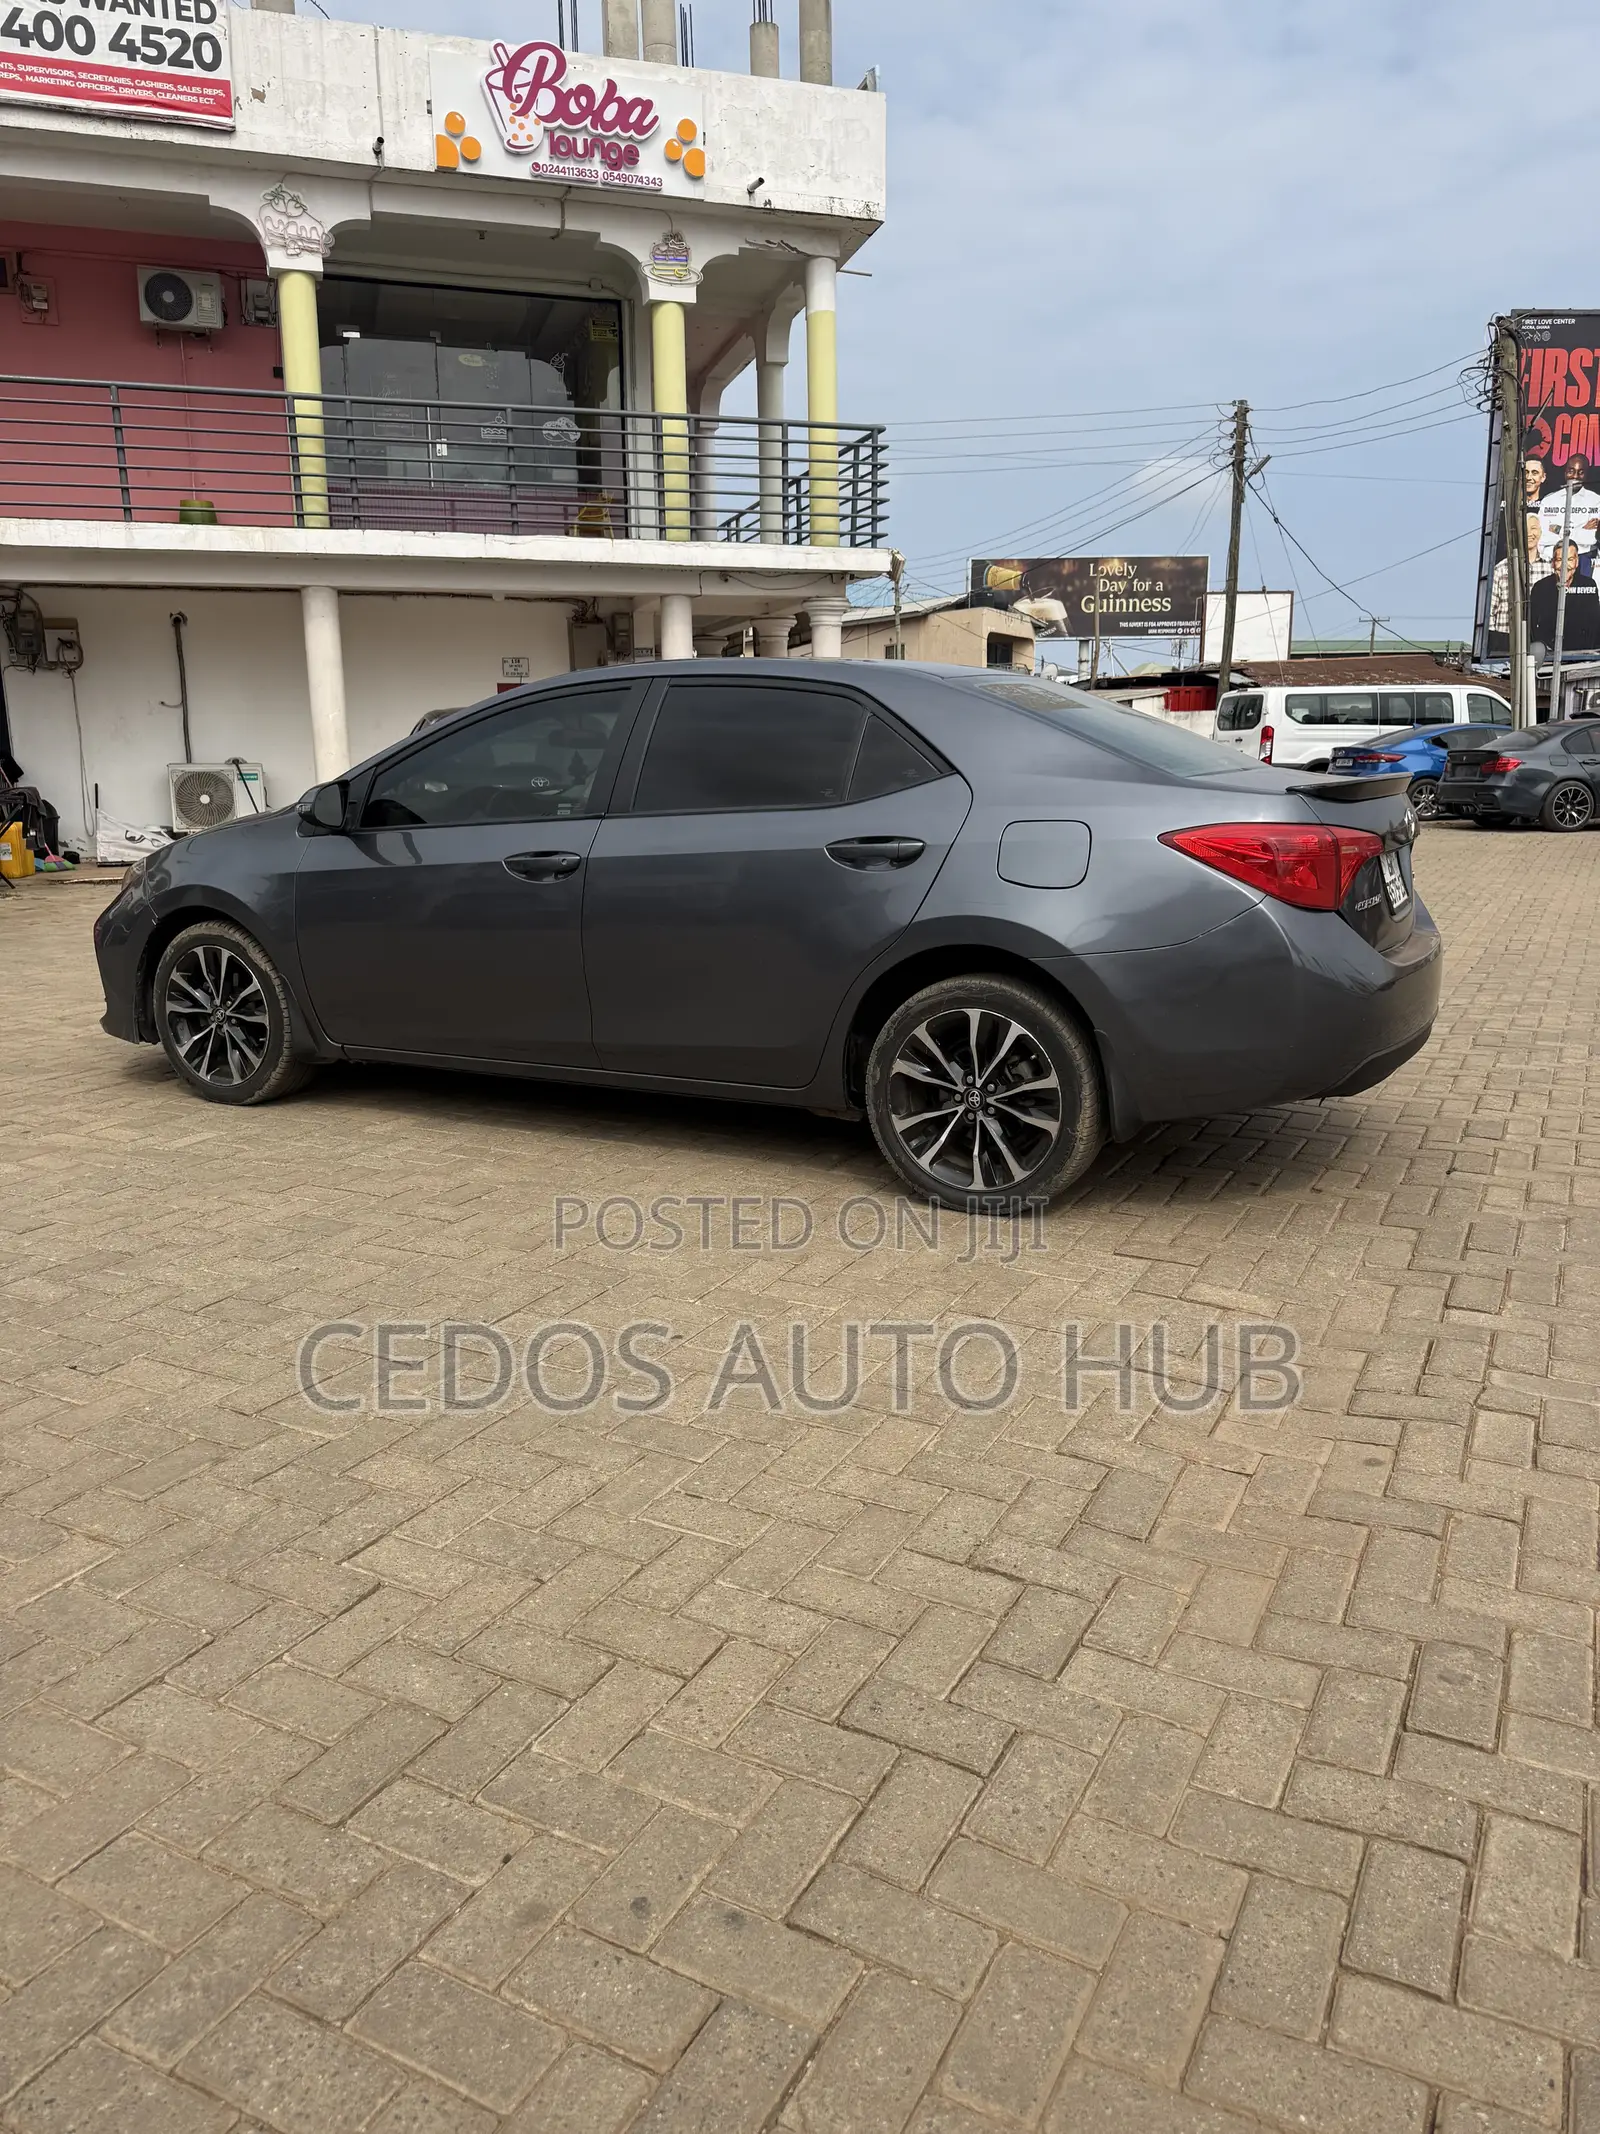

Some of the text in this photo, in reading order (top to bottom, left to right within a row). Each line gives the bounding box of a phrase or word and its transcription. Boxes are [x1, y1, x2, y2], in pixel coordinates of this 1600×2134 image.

[0, 7, 222, 72] 400 4520
[17, 64, 77, 79] SUPERVISORS,
[78, 72, 134, 87] SECRETARIES,
[135, 79, 177, 91] CASHIERS,
[177, 85, 202, 94] SALES
[203, 88, 226, 98] REPS,
[25, 75, 75, 87] MARKETING
[76, 81, 118, 94] OFFICERS,
[119, 87, 156, 98] DRIVERS,
[156, 91, 198, 103] CLEANERS
[199, 97, 216, 105] ECT.
[502, 41, 659, 135] Boba
[548, 132, 640, 170] lounge
[541, 163, 663, 187] 0244113633 0549074343
[1543, 506, 1560, 514] DAVID
[1560, 506, 1587, 514] ODEPO
[1089, 562, 1138, 579] Lovely
[1099, 578, 1164, 595] Day for a
[1565, 586, 1596, 594] OHN BEVERE
[1081, 594, 1172, 613] Guinness
